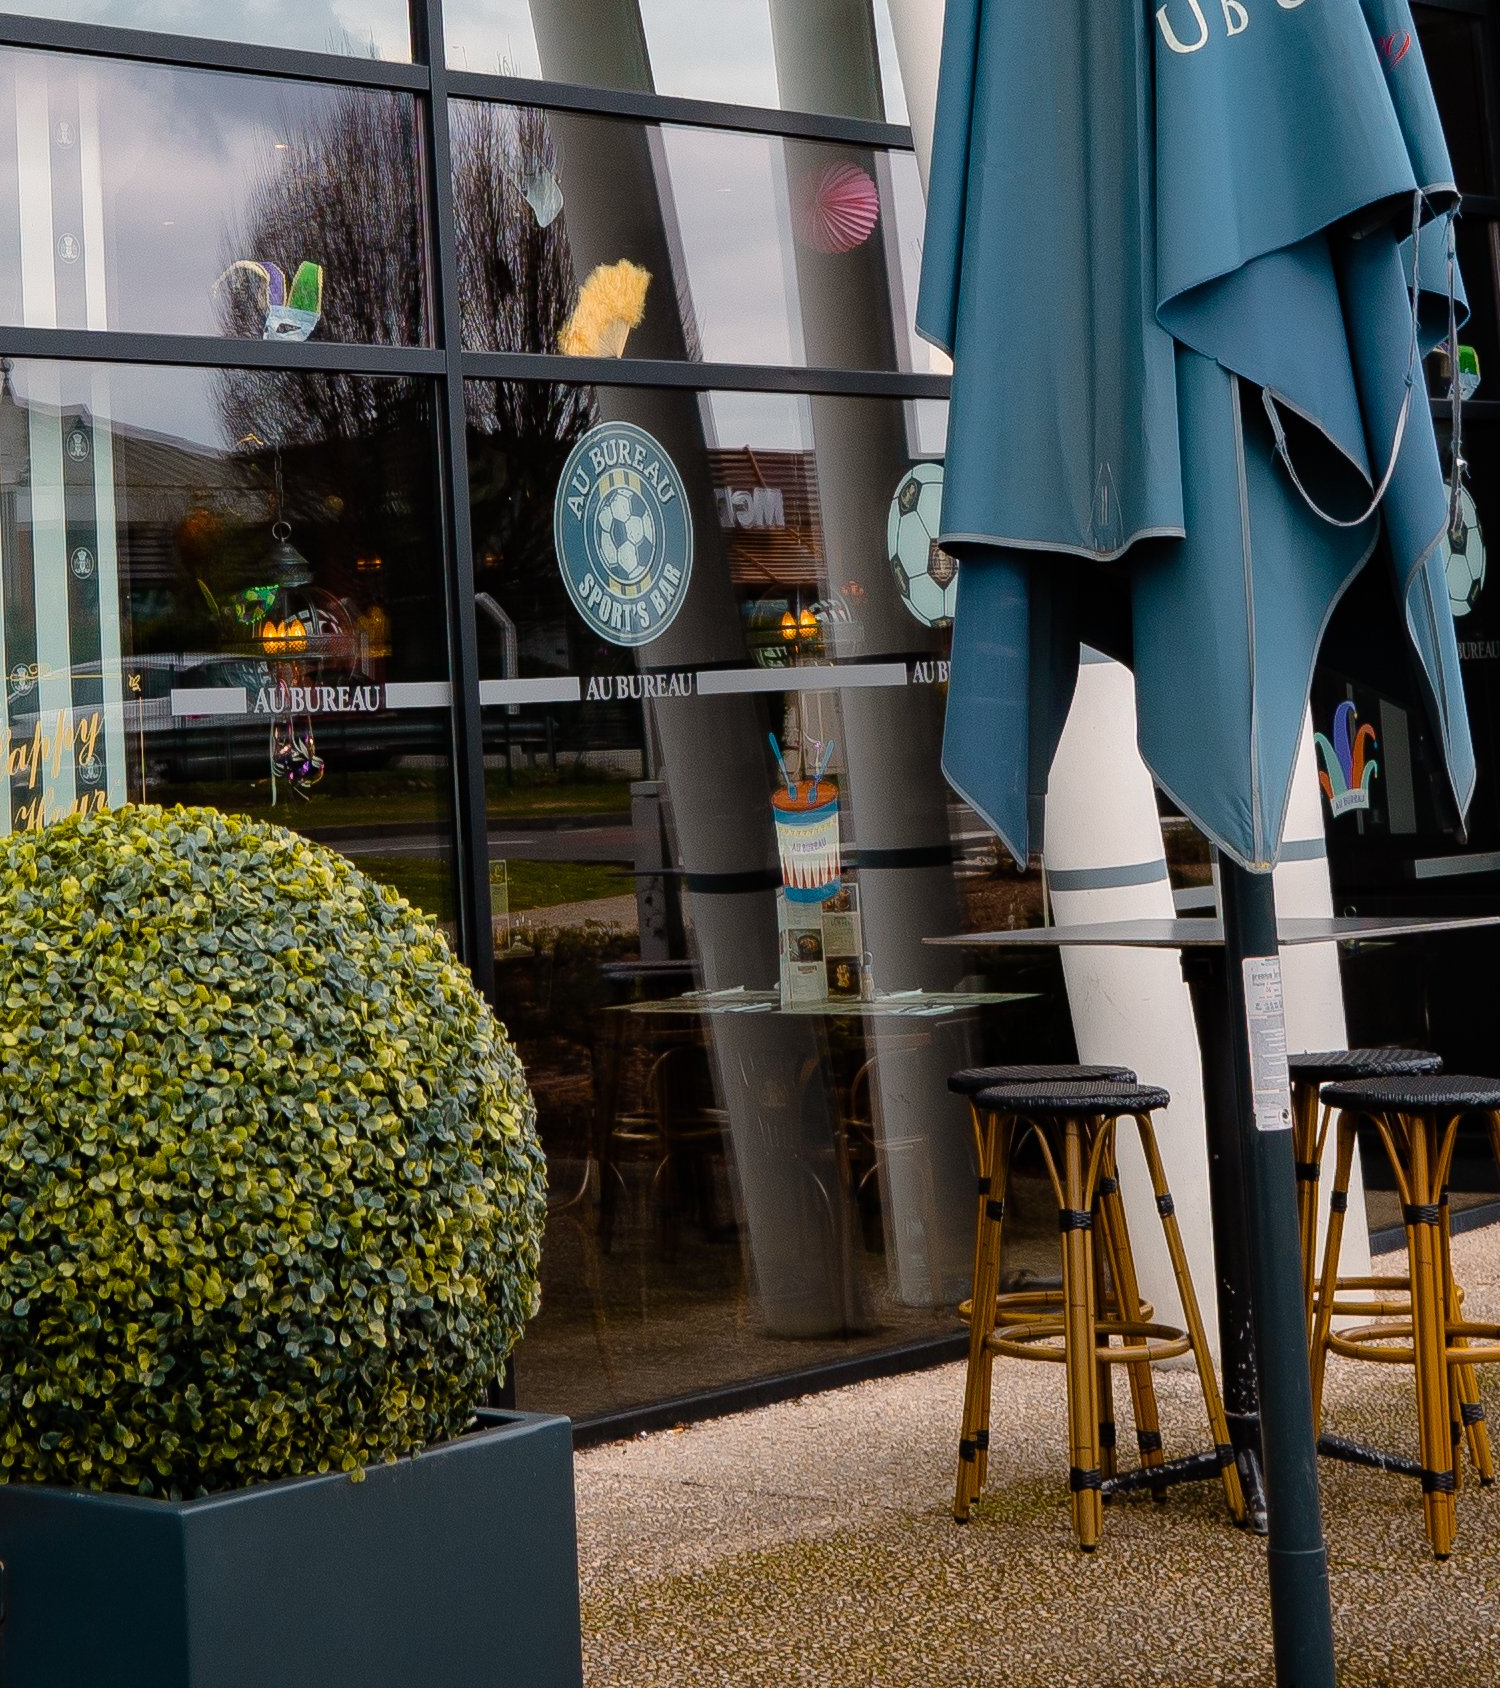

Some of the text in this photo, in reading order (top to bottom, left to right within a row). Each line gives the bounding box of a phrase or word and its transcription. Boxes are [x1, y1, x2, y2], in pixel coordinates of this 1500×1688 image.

[567, 438, 676, 520] AU BUREAU
[579, 563, 682, 632] SPORT'S BAR
[913, 660, 951, 684] AU B
[254, 685, 380, 713] AU BUREAU
[586, 673, 692, 700] AU BUREAU
